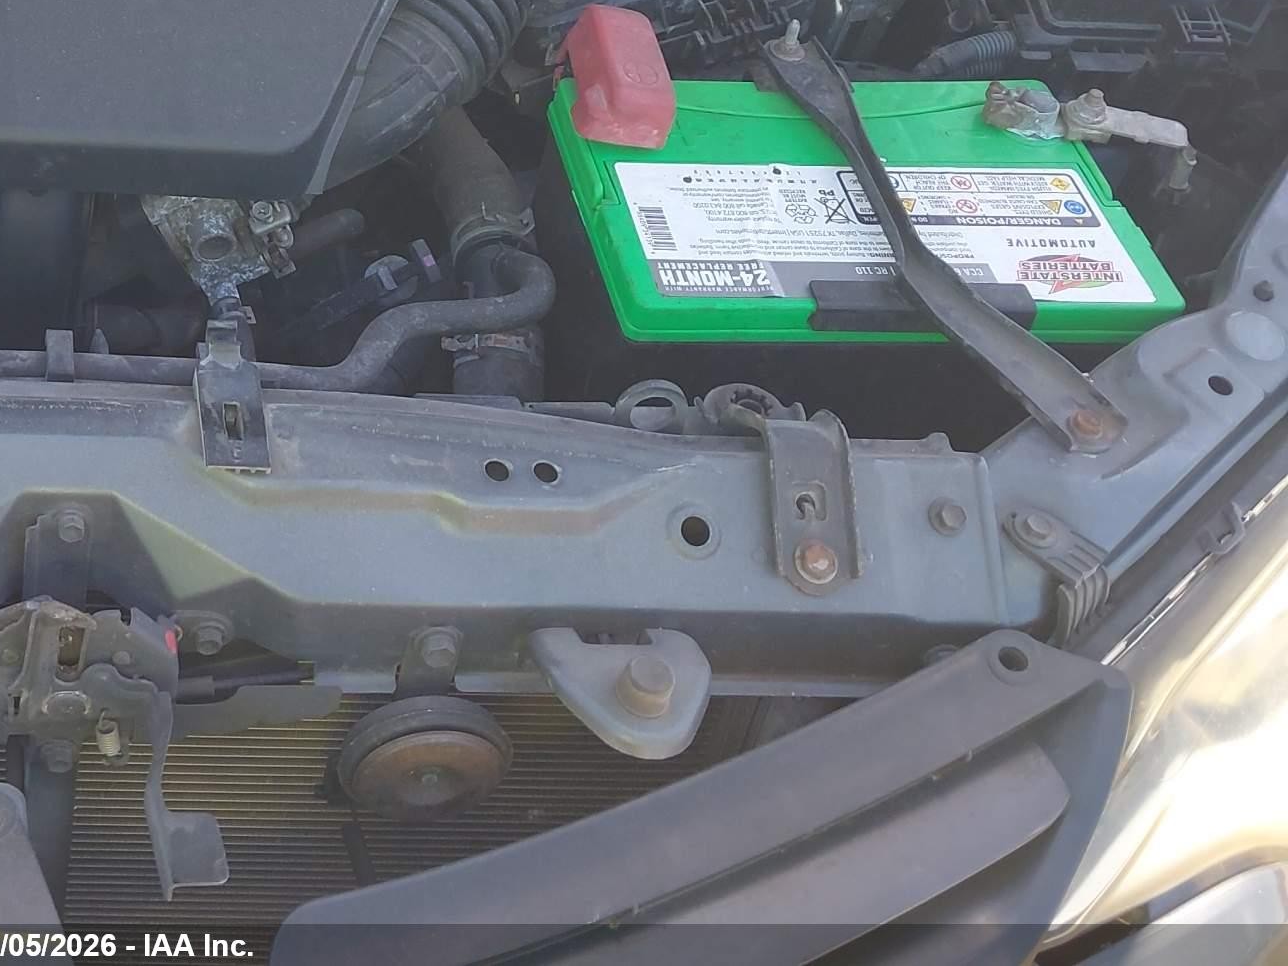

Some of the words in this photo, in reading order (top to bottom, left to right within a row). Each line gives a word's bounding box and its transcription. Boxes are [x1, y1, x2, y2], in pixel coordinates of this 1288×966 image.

[956, 217, 1062, 225] DANGER/POISON
[1005, 238, 1096, 248] AUTOMOTIVE
[656, 262, 734, 271] REPLACEMENT
[736, 262, 765, 271] FREE
[855, 266, 873, 275] 110
[874, 266, 889, 275] RC
[1021, 262, 1111, 271] BATTERIES
[962, 267, 984, 276] CCA
[658, 269, 771, 287] 24-MONTH
[1018, 271, 1120, 282] INTERSTATE
